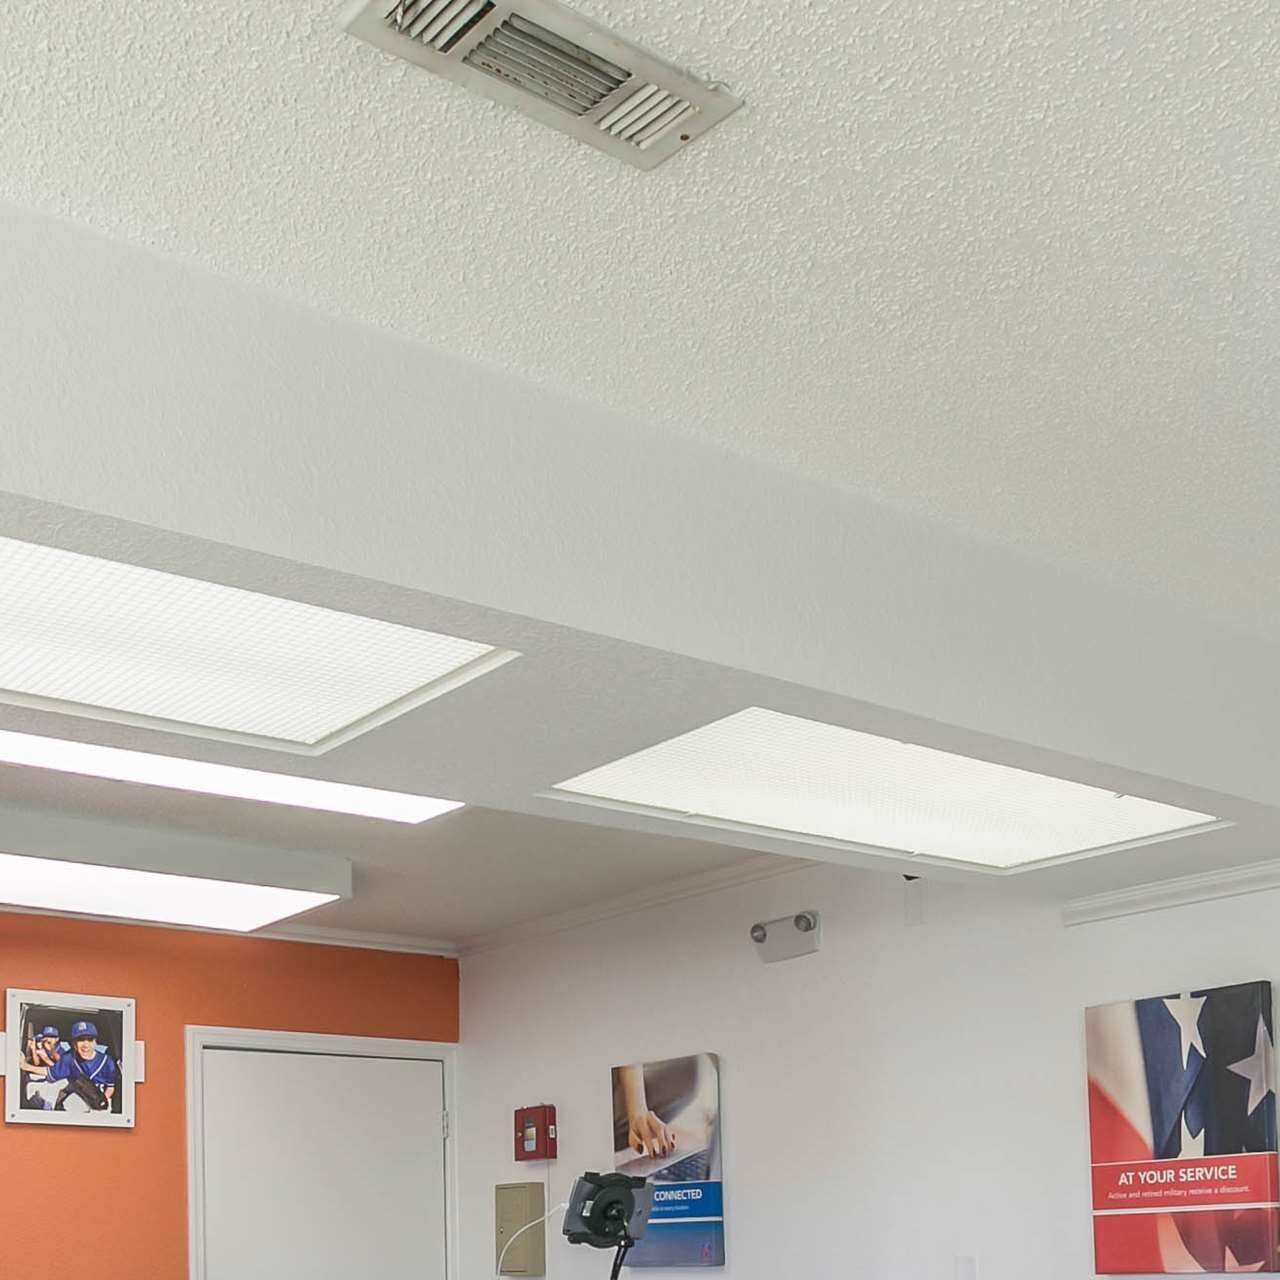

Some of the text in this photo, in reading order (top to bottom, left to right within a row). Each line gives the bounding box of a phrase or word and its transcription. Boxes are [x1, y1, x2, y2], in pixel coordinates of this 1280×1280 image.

[1118, 1165, 1237, 1186] AT YOUR SERVICE
[654, 1188, 703, 1201] CONNECTED
